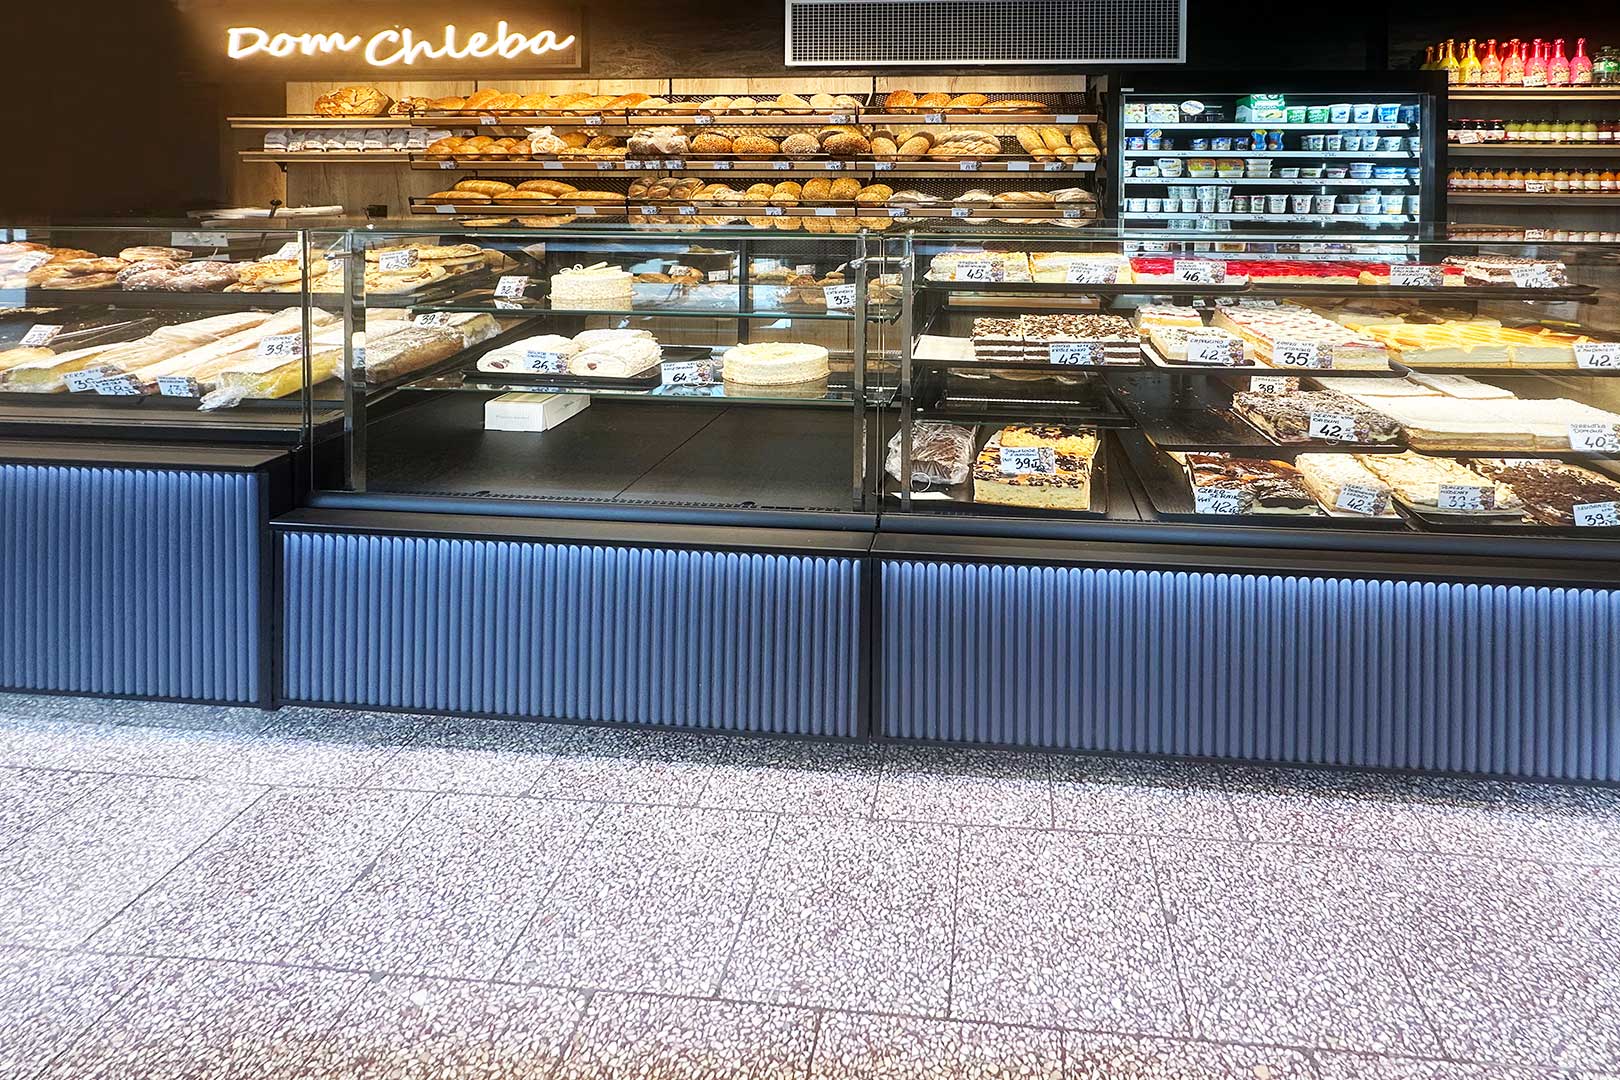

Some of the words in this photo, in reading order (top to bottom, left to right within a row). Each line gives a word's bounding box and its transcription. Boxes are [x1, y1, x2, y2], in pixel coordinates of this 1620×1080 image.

[227, 27, 361, 58] Dom
[364, 21, 576, 66] Chleba
[1058, 353, 1081, 365] 45
[1584, 436, 1606, 449] 40
